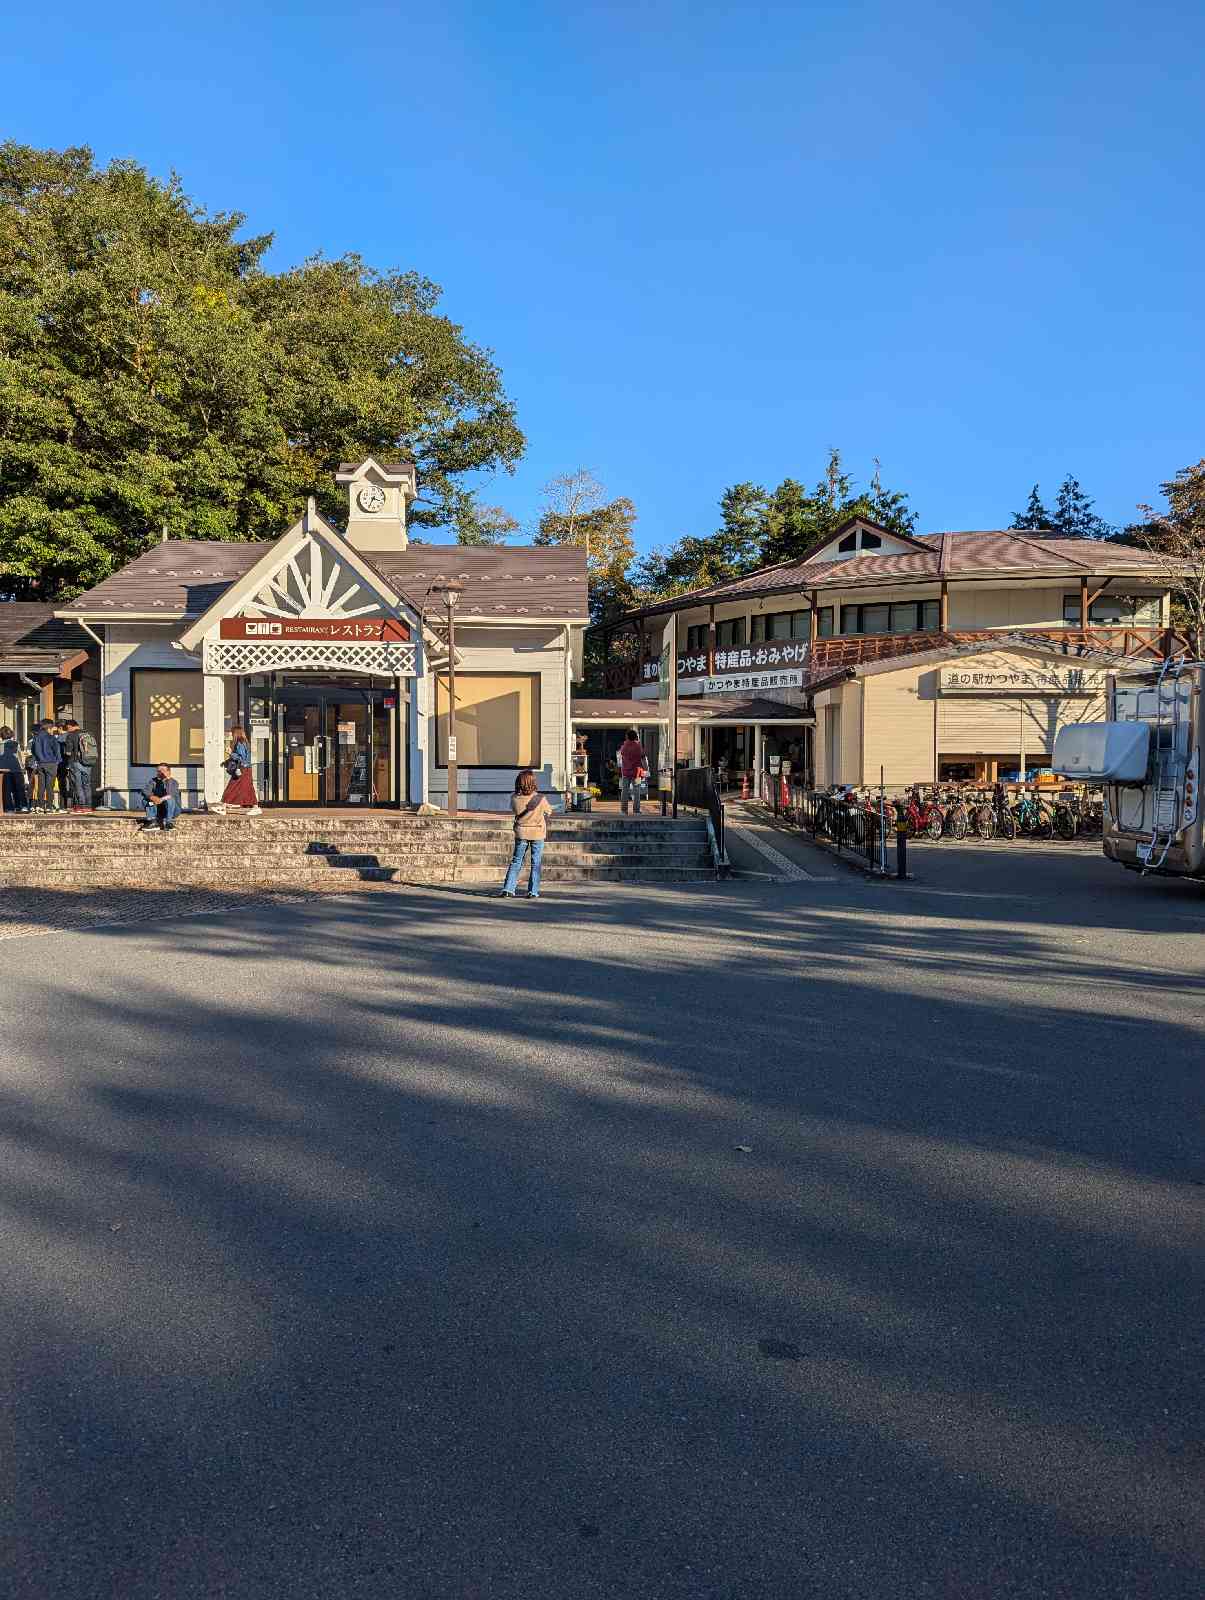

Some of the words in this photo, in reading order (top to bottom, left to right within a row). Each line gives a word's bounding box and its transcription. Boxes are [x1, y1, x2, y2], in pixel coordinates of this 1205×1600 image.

[330, 625, 384, 637] レストラン
[643, 655, 707, 678] 道のつやま
